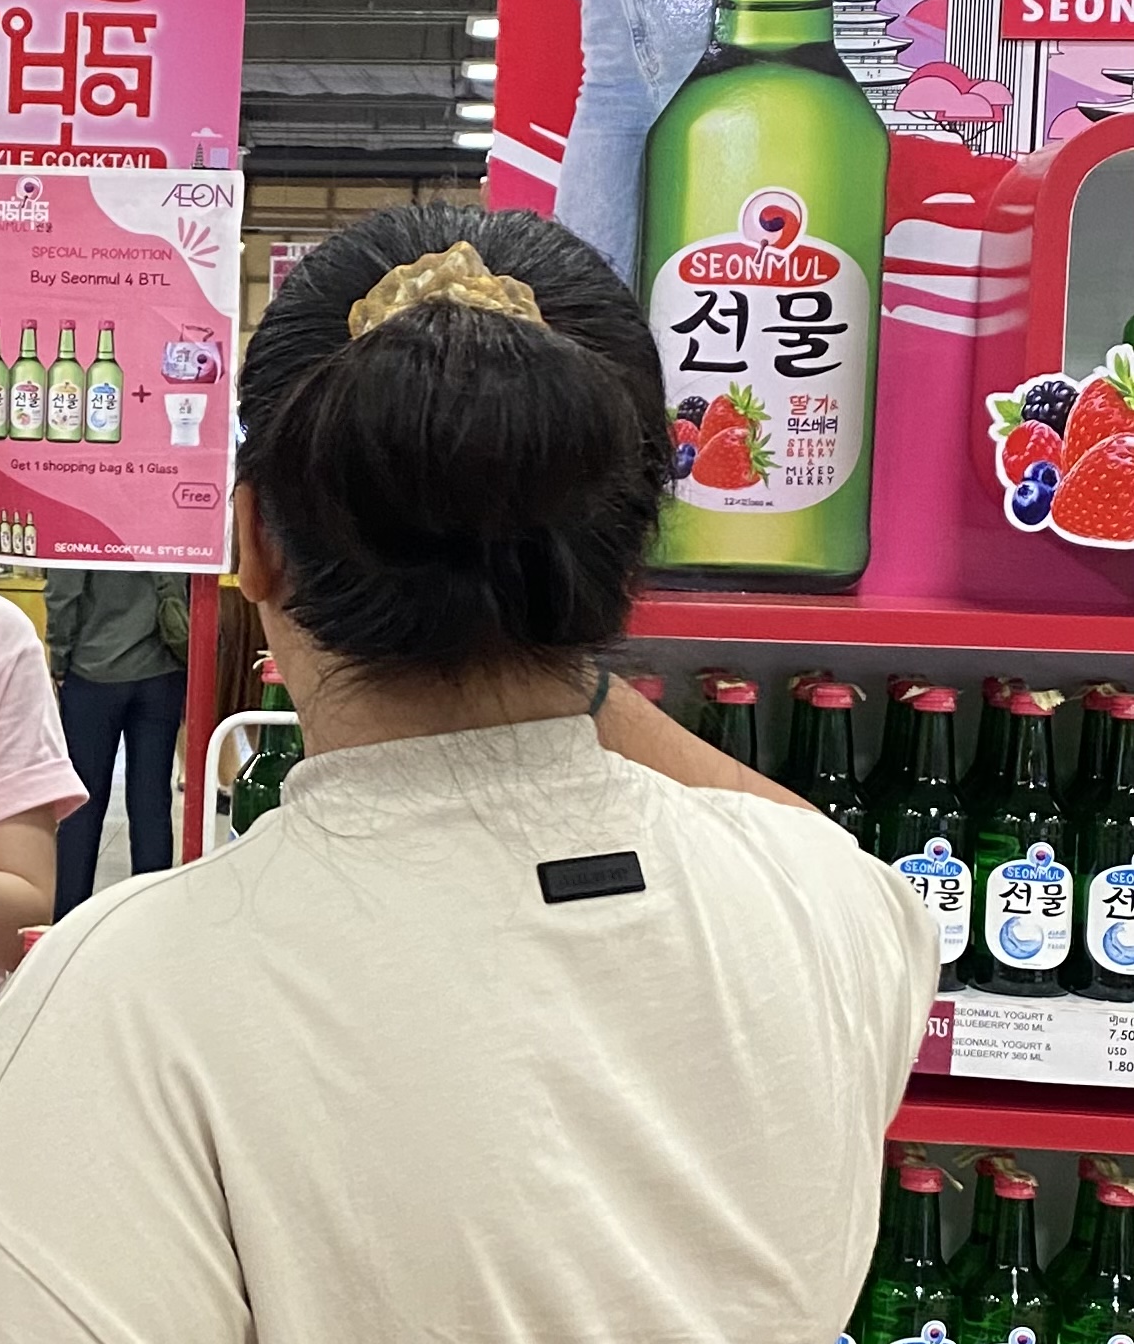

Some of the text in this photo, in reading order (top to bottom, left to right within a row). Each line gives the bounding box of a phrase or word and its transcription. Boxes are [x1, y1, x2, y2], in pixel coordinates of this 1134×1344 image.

[31, 246, 173, 261] SPECIAL PROMOTION
[689, 251, 829, 283] SEONMUL
[30, 270, 171, 286] Buy Seonmul 4 BTL
[670, 290, 848, 378] 선물
[787, 438, 836, 448] STRAW
[786, 448, 835, 458] BERRY
[10, 458, 30, 471] Get
[43, 459, 95, 475] shopping
[100, 461, 122, 476] bag
[125, 463, 135, 474] &
[147, 463, 179, 475] Glass
[786, 466, 835, 476] MIXED
[786, 476, 834, 486] BERRY
[181, 488, 212, 503] Free
[54, 542, 102, 555] SEONMUL
[187, 546, 213, 557] SOJU
[903, 861, 958, 877] SEONMUL
[1006, 866, 1062, 882] SEONMUL
[998, 882, 1067, 917] 선물
[1004, 1011, 1044, 1021] YOGURT
[1046, 1014, 1053, 1022] &
[1013, 1022, 1030, 1031] 360
[1032, 1023, 1045, 1032] ML
[1002, 1040, 1042, 1051] YOGURT
[1045, 1043, 1052, 1052] &
[1107, 1046, 1127, 1057] USD
[1012, 1051, 1028, 1061] 360
[1030, 1053, 1044, 1061] ML
